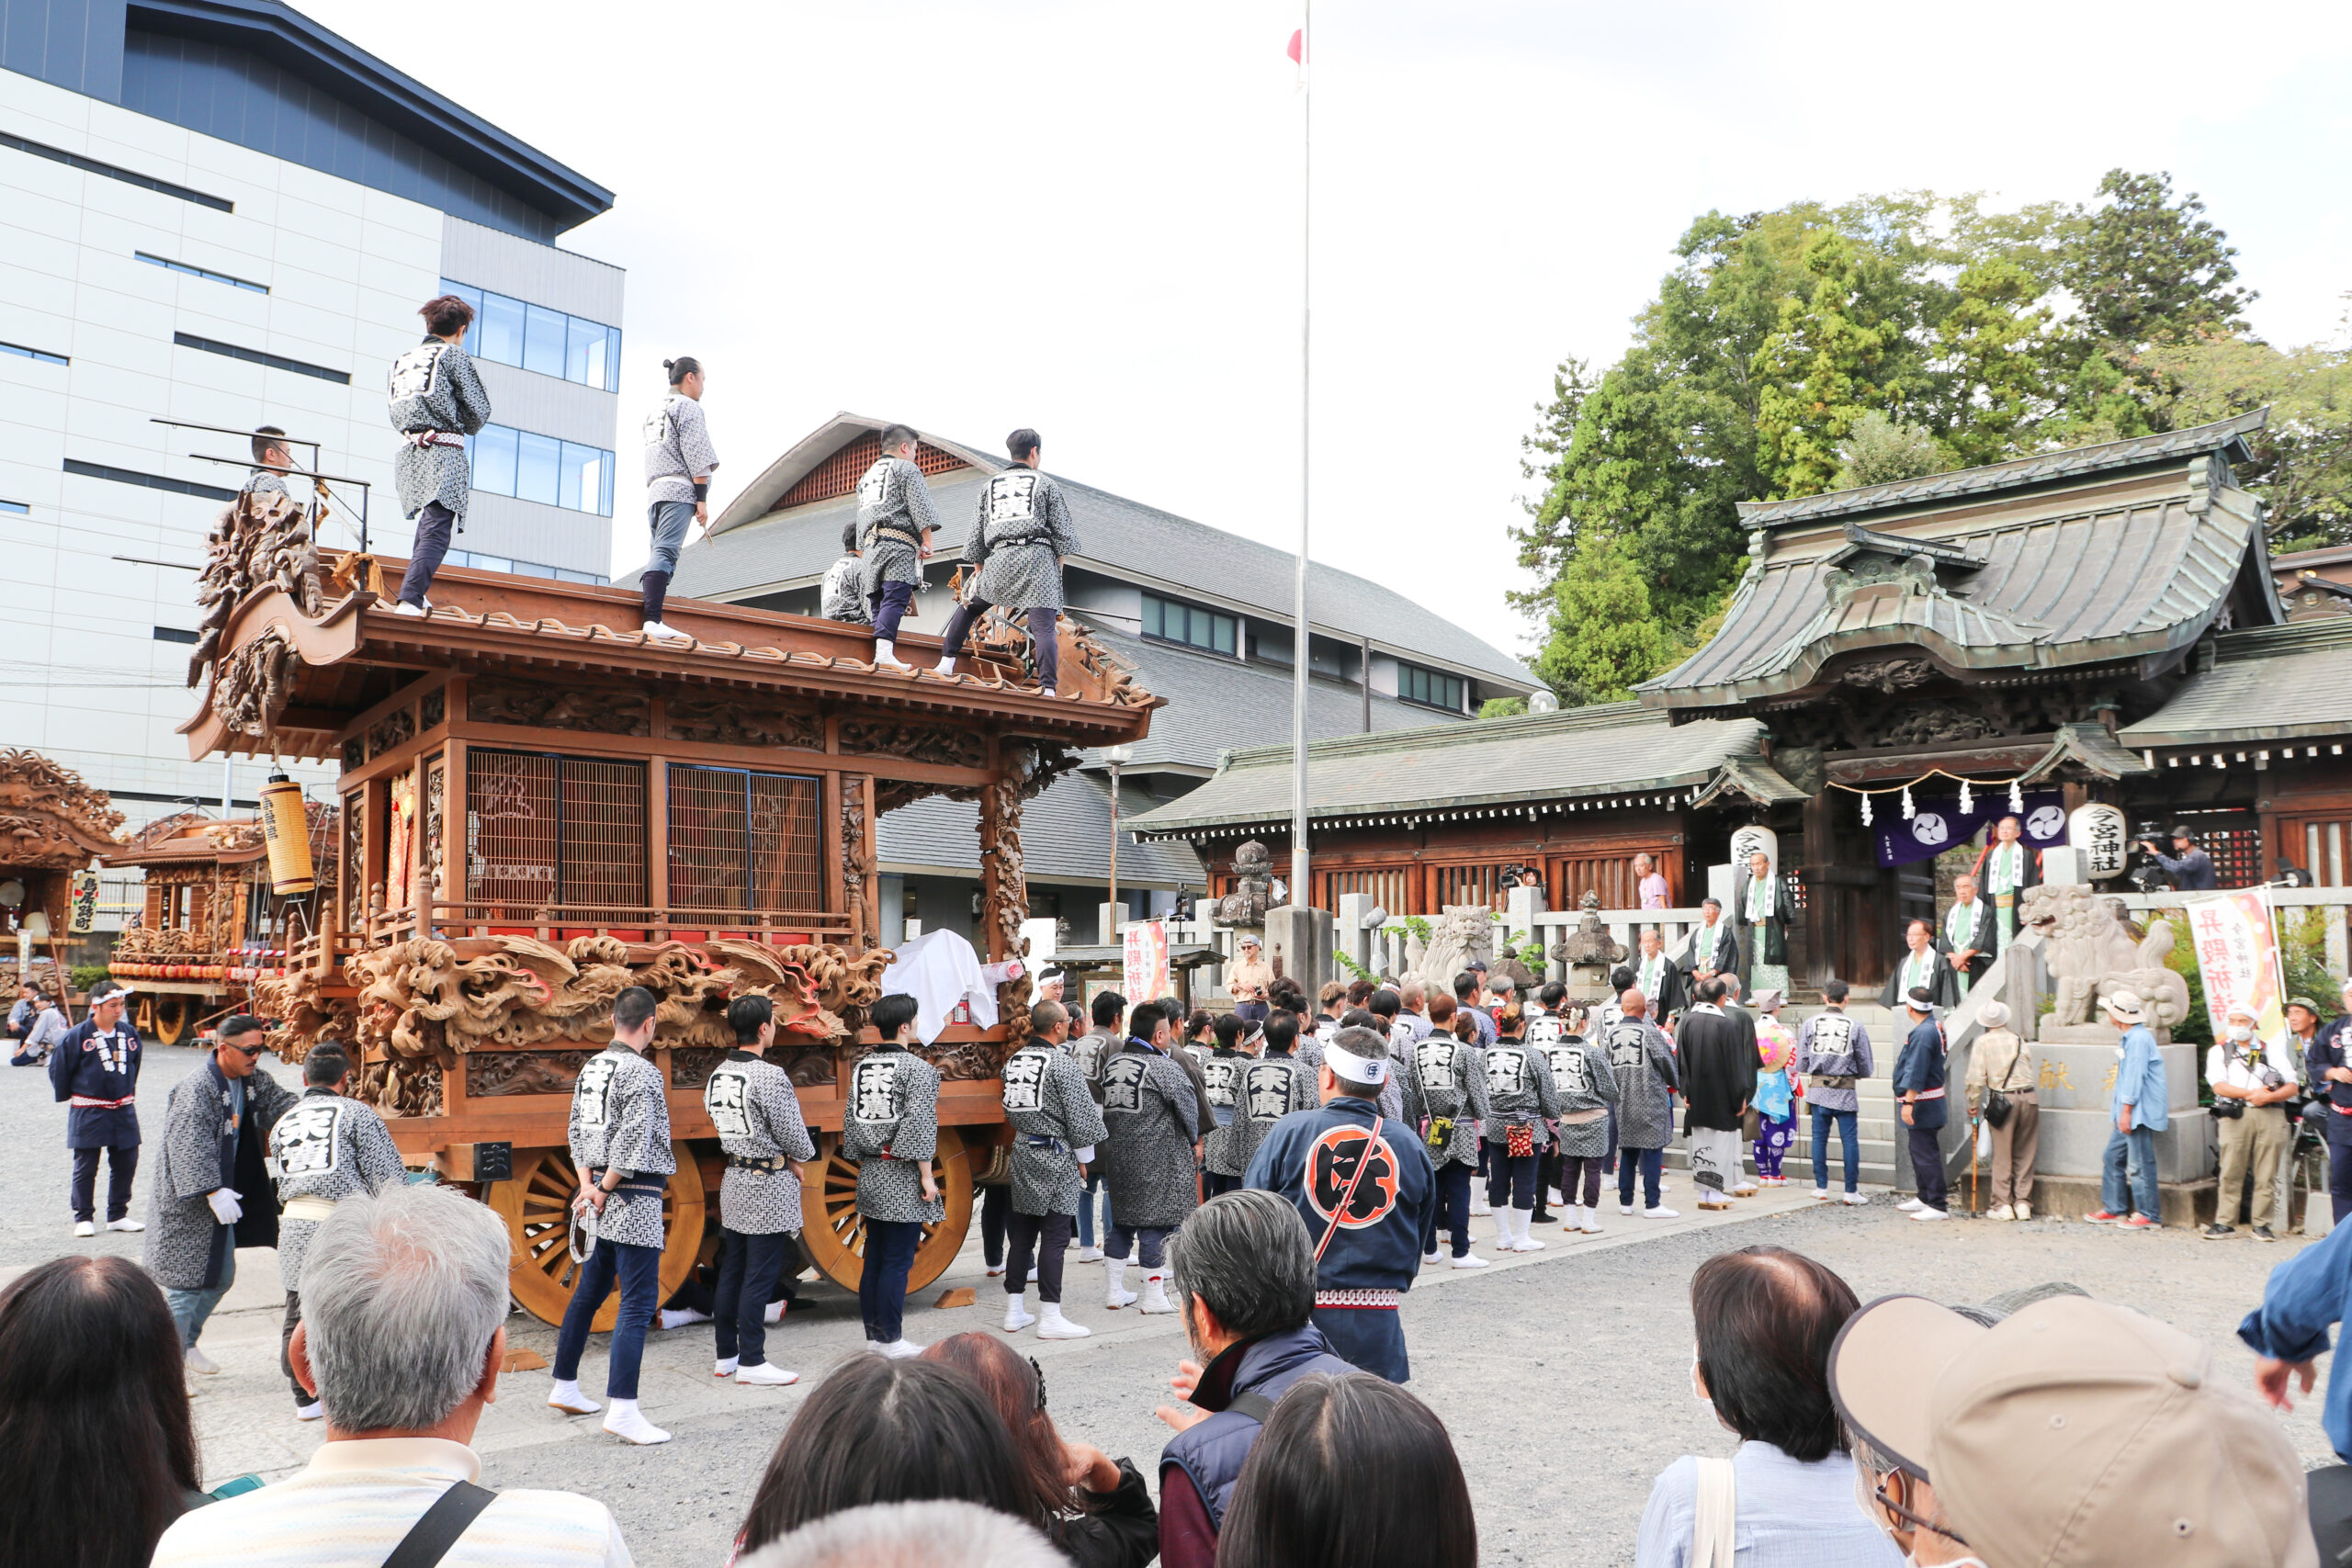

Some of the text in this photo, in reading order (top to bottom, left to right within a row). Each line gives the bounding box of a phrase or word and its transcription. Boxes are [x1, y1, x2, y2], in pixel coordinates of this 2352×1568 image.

[2087, 808, 2120, 872] 今宮神社
[75, 877, 97, 931] 鳥居跡町
[1366, 1065, 1379, 1077] ほ
